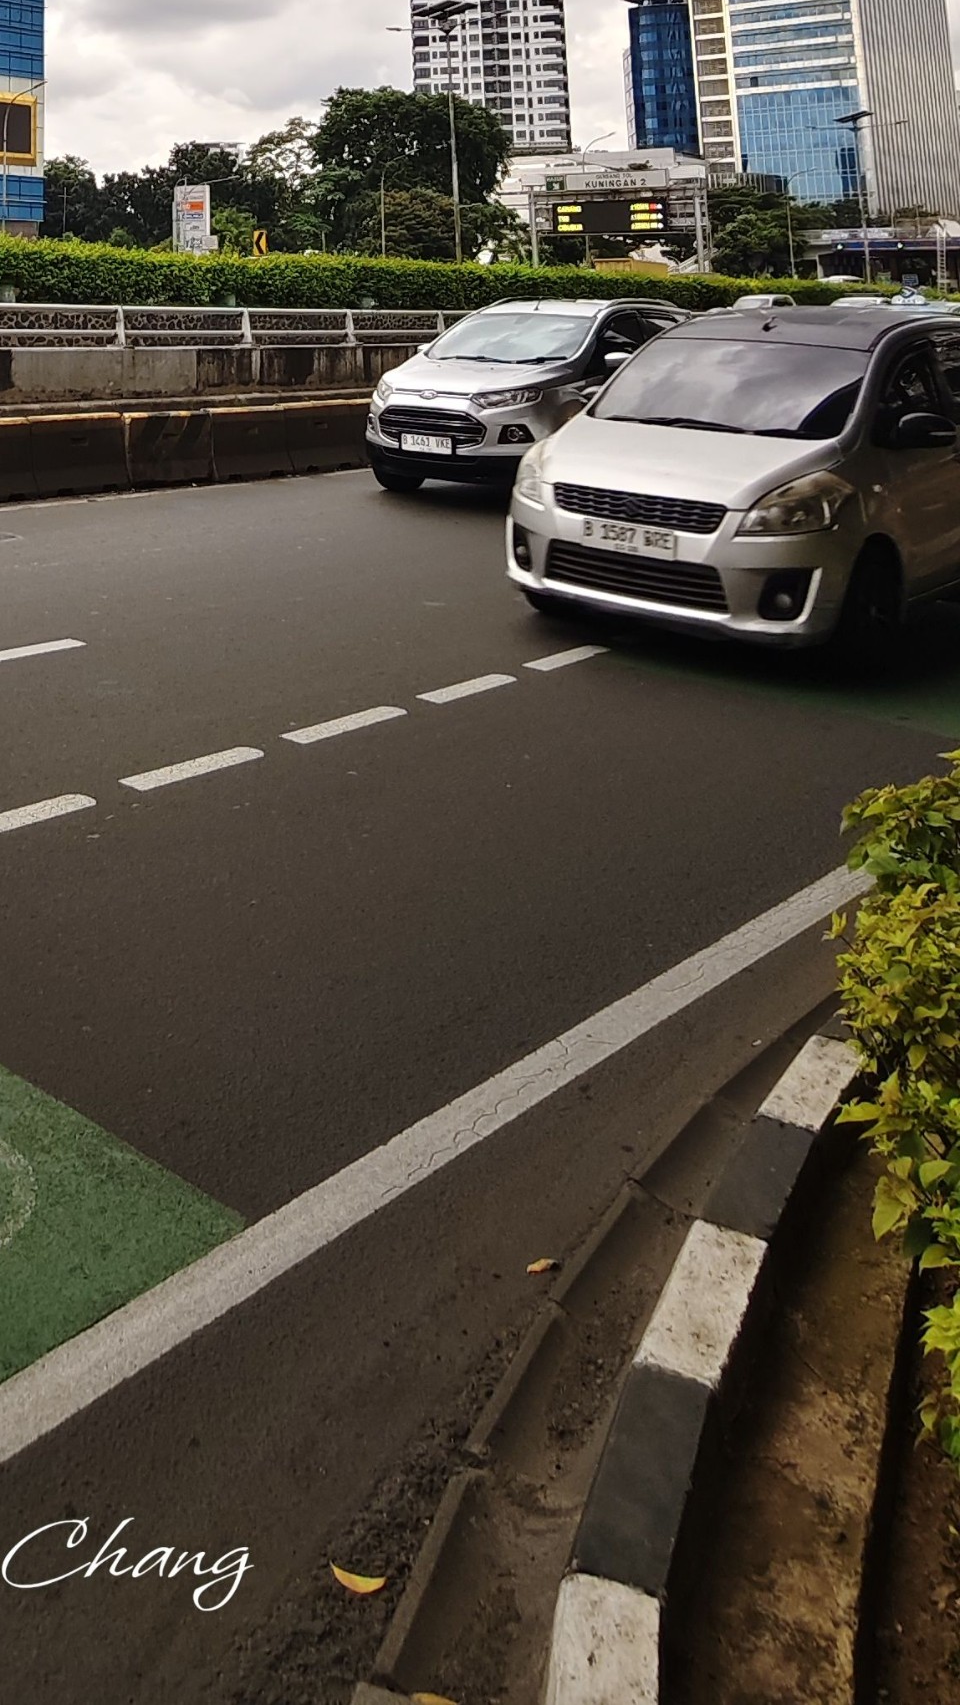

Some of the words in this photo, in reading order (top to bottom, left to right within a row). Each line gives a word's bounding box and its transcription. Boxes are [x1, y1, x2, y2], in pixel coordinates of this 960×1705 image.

[585, 180, 637, 188] KUNINGAN
[641, 178, 647, 186] 2
[403, 434, 408, 445] B
[435, 438, 450, 448] VKE
[583, 520, 593, 537] B
[600, 523, 637, 543] 1587
